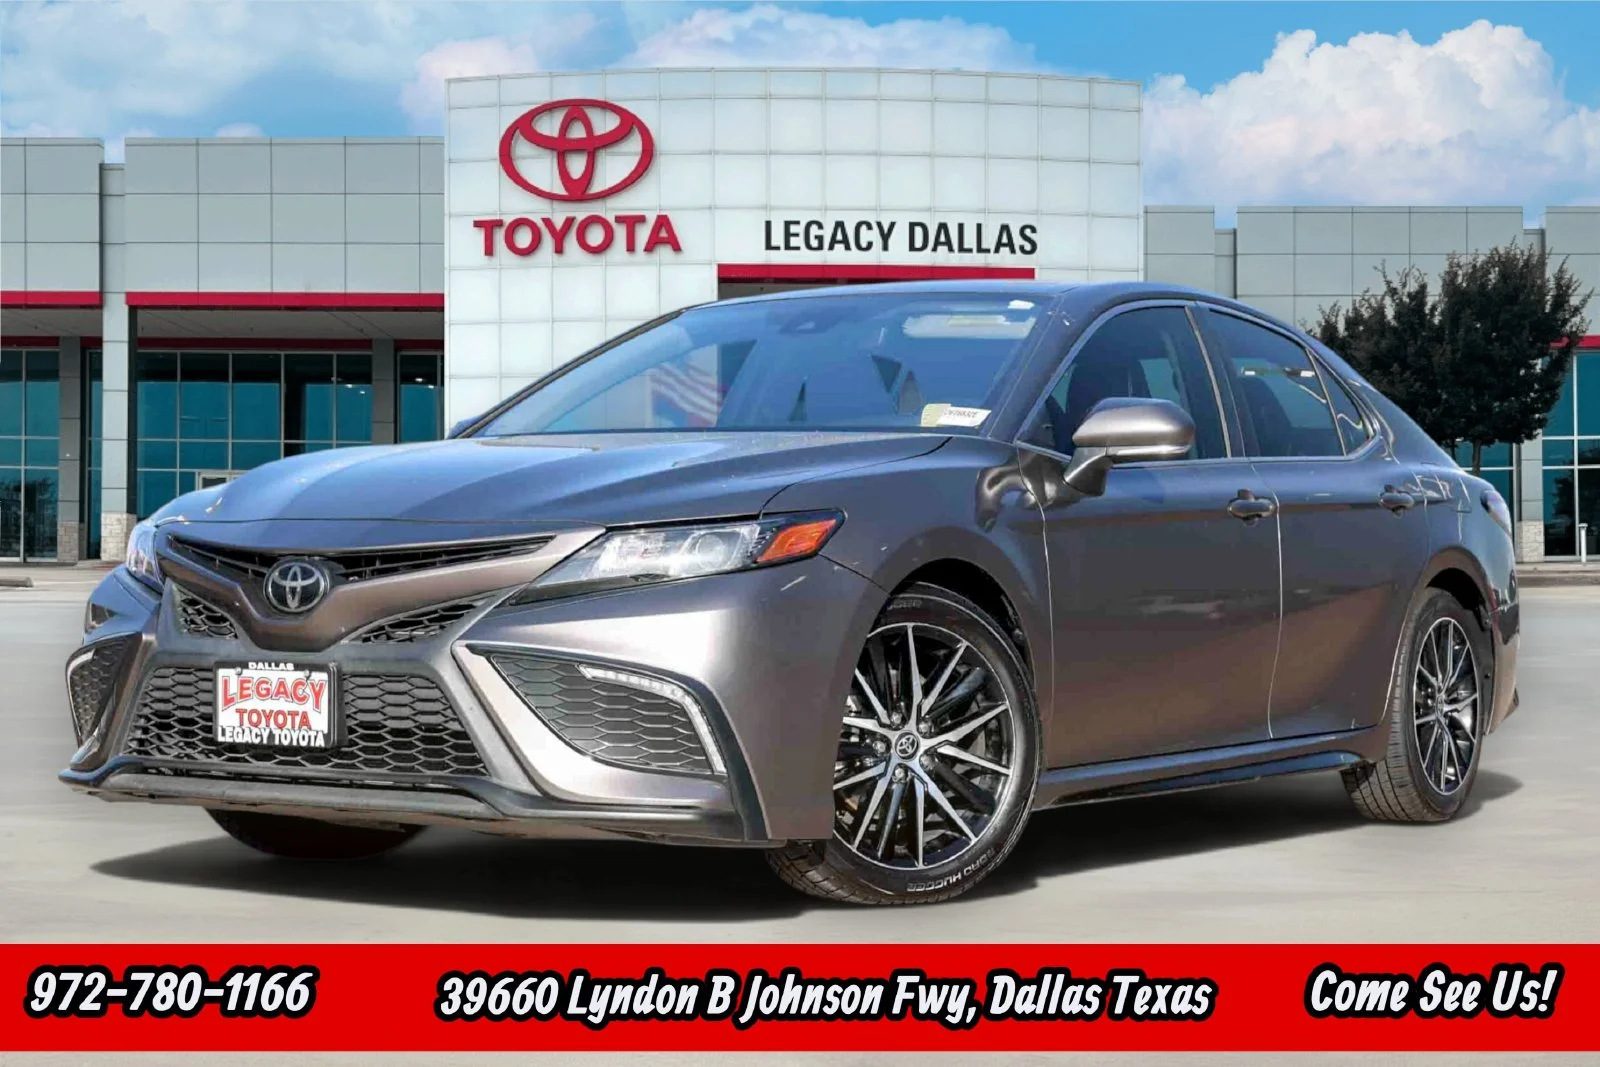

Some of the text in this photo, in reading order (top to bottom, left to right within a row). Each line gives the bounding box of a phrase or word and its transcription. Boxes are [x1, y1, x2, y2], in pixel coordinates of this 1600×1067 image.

[474, 214, 681, 257] TOYOTA
[765, 220, 1038, 255] LEGACY DALLAS
[248, 661, 294, 671] DALLAS
[221, 676, 328, 714] LEGACY
[235, 708, 312, 730] TOYOTA
[217, 726, 325, 747] LEGACY TOYOTA
[907, 872, 962, 892] HUGGER
